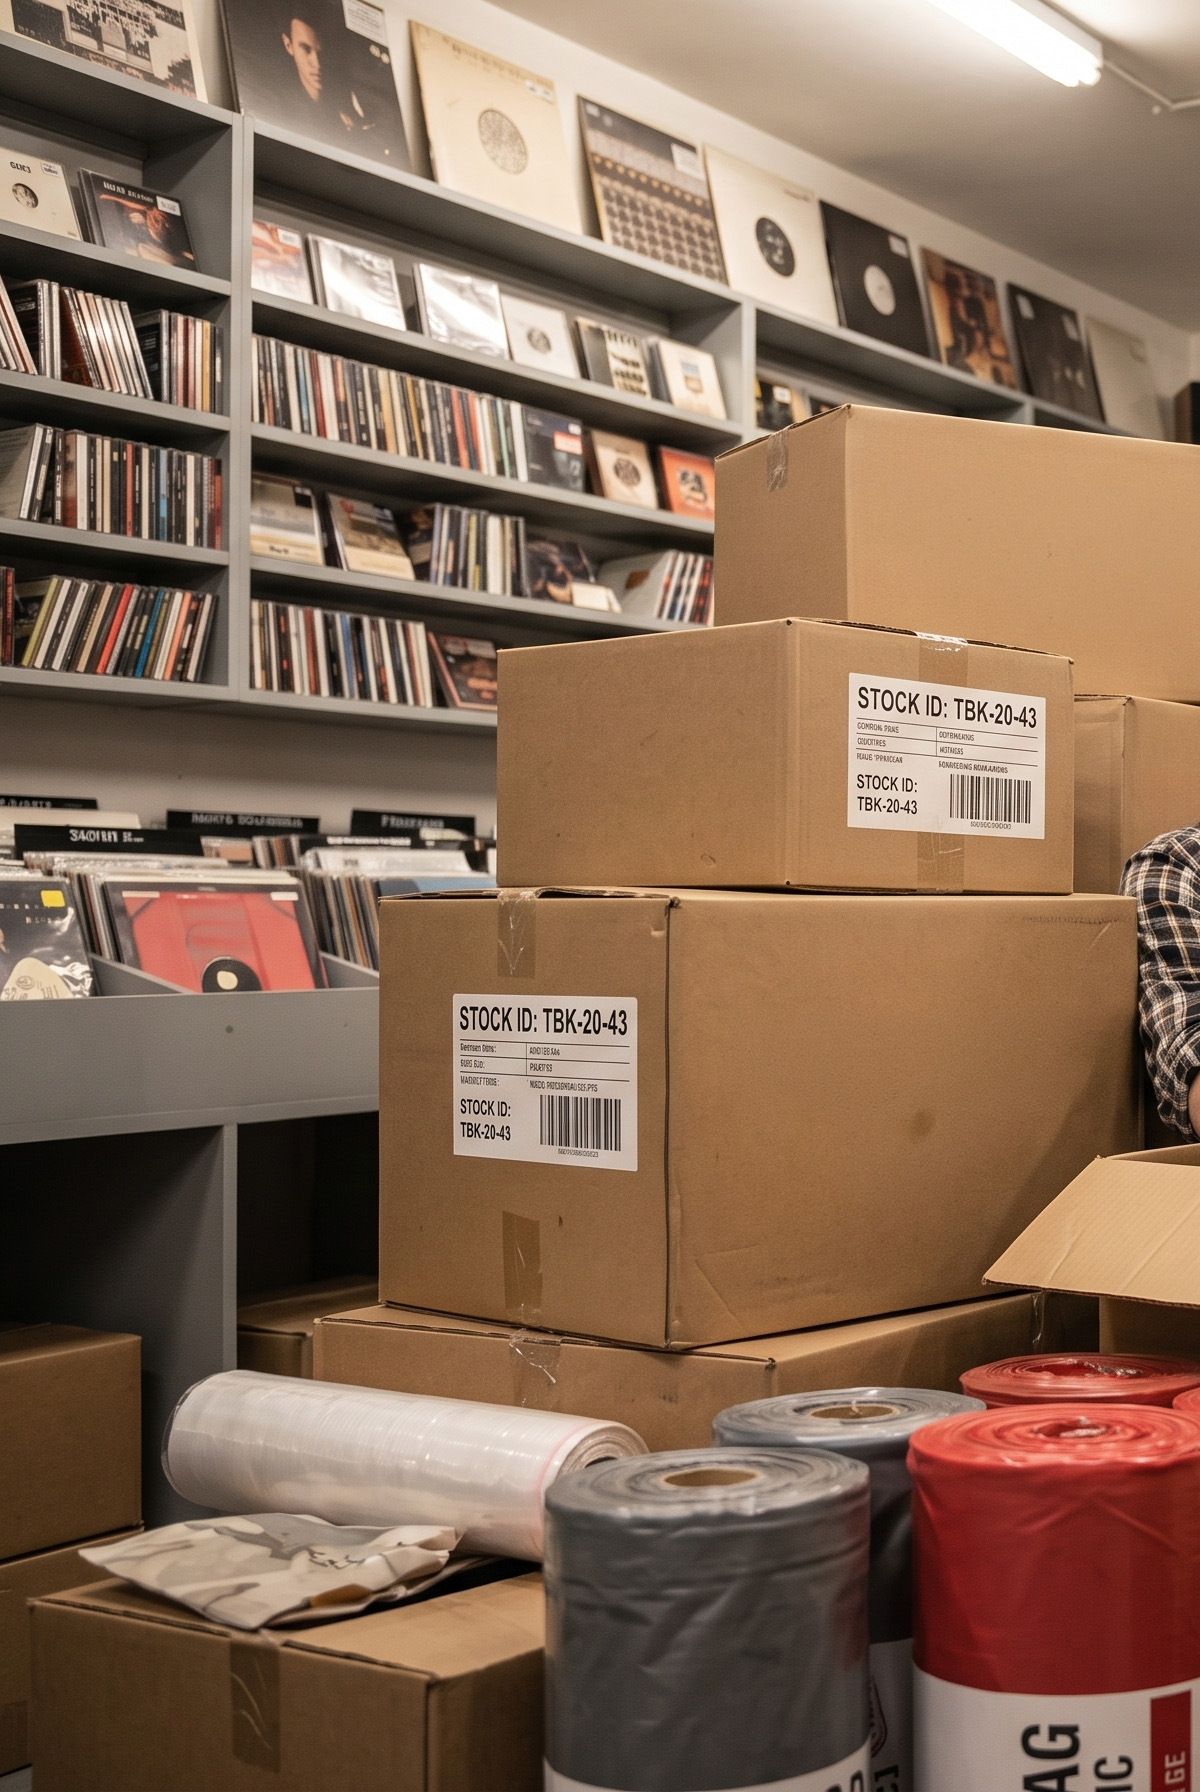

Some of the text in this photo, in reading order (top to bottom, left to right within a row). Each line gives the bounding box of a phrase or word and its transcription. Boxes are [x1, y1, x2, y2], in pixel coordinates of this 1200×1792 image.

[858, 686, 1037, 728] STOCK ID: TBK-20-43
[857, 773, 918, 793] STOCK ID:
[857, 796, 918, 815] TBK-20-43
[460, 1005, 628, 1036] STOCK ID: TBK-20-43
[460, 1098, 511, 1117] STOCK ID:
[460, 1121, 511, 1141] TBK-20-43
[1021, 1724, 1081, 1792] AG
[1164, 1751, 1186, 1792] GE
